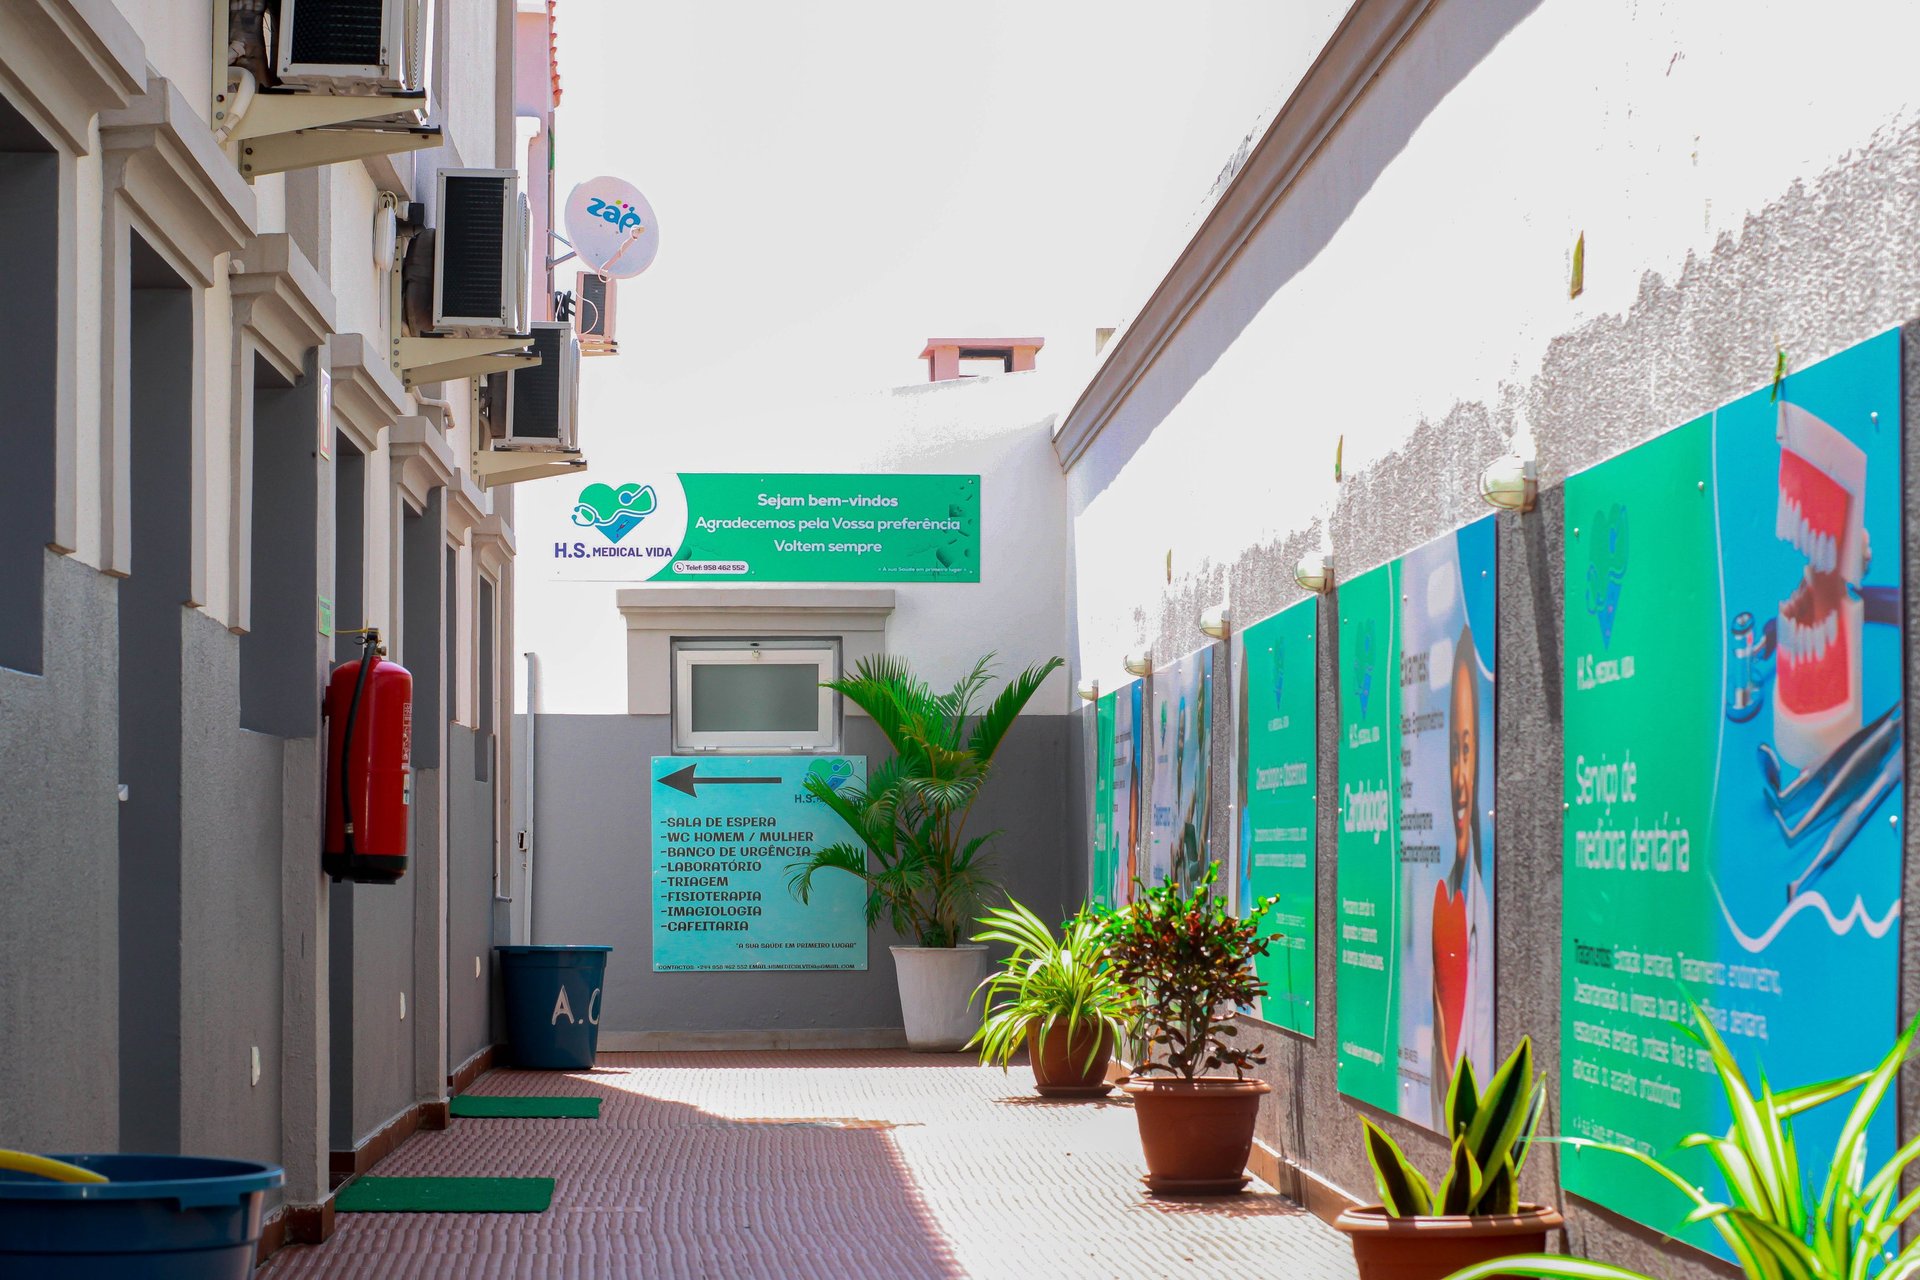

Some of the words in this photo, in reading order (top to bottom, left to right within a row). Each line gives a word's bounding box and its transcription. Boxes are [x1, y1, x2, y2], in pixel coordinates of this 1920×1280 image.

[587, 197, 641, 233] zap
[757, 493, 805, 510] Sejam
[808, 493, 899, 507] bem-vindos
[695, 516, 796, 533] Agradecemos
[798, 517, 830, 532] pela
[832, 517, 875, 530] Vossa
[877, 517, 961, 533] preferência
[554, 542, 591, 559] H.S.
[592, 547, 643, 558] MEDICAL
[645, 547, 673, 558] VIDA
[773, 539, 826, 552] Voltem
[828, 541, 883, 556] sempre
[1575, 752, 1619, 816] Serviço
[1620, 748, 1638, 803] de
[1343, 778, 1389, 845] Cardiologia
[705, 816, 722, 828] DE
[726, 816, 777, 828] ESPERA
[694, 831, 745, 843] HOMEM
[748, 831, 756, 843] /
[759, 831, 814, 843] MULHER
[1575, 818, 1627, 870] medicina
[1630, 811, 1690, 873] dentária
[719, 846, 736, 858] DE
[740, 844, 811, 858] URGÊNCIA
